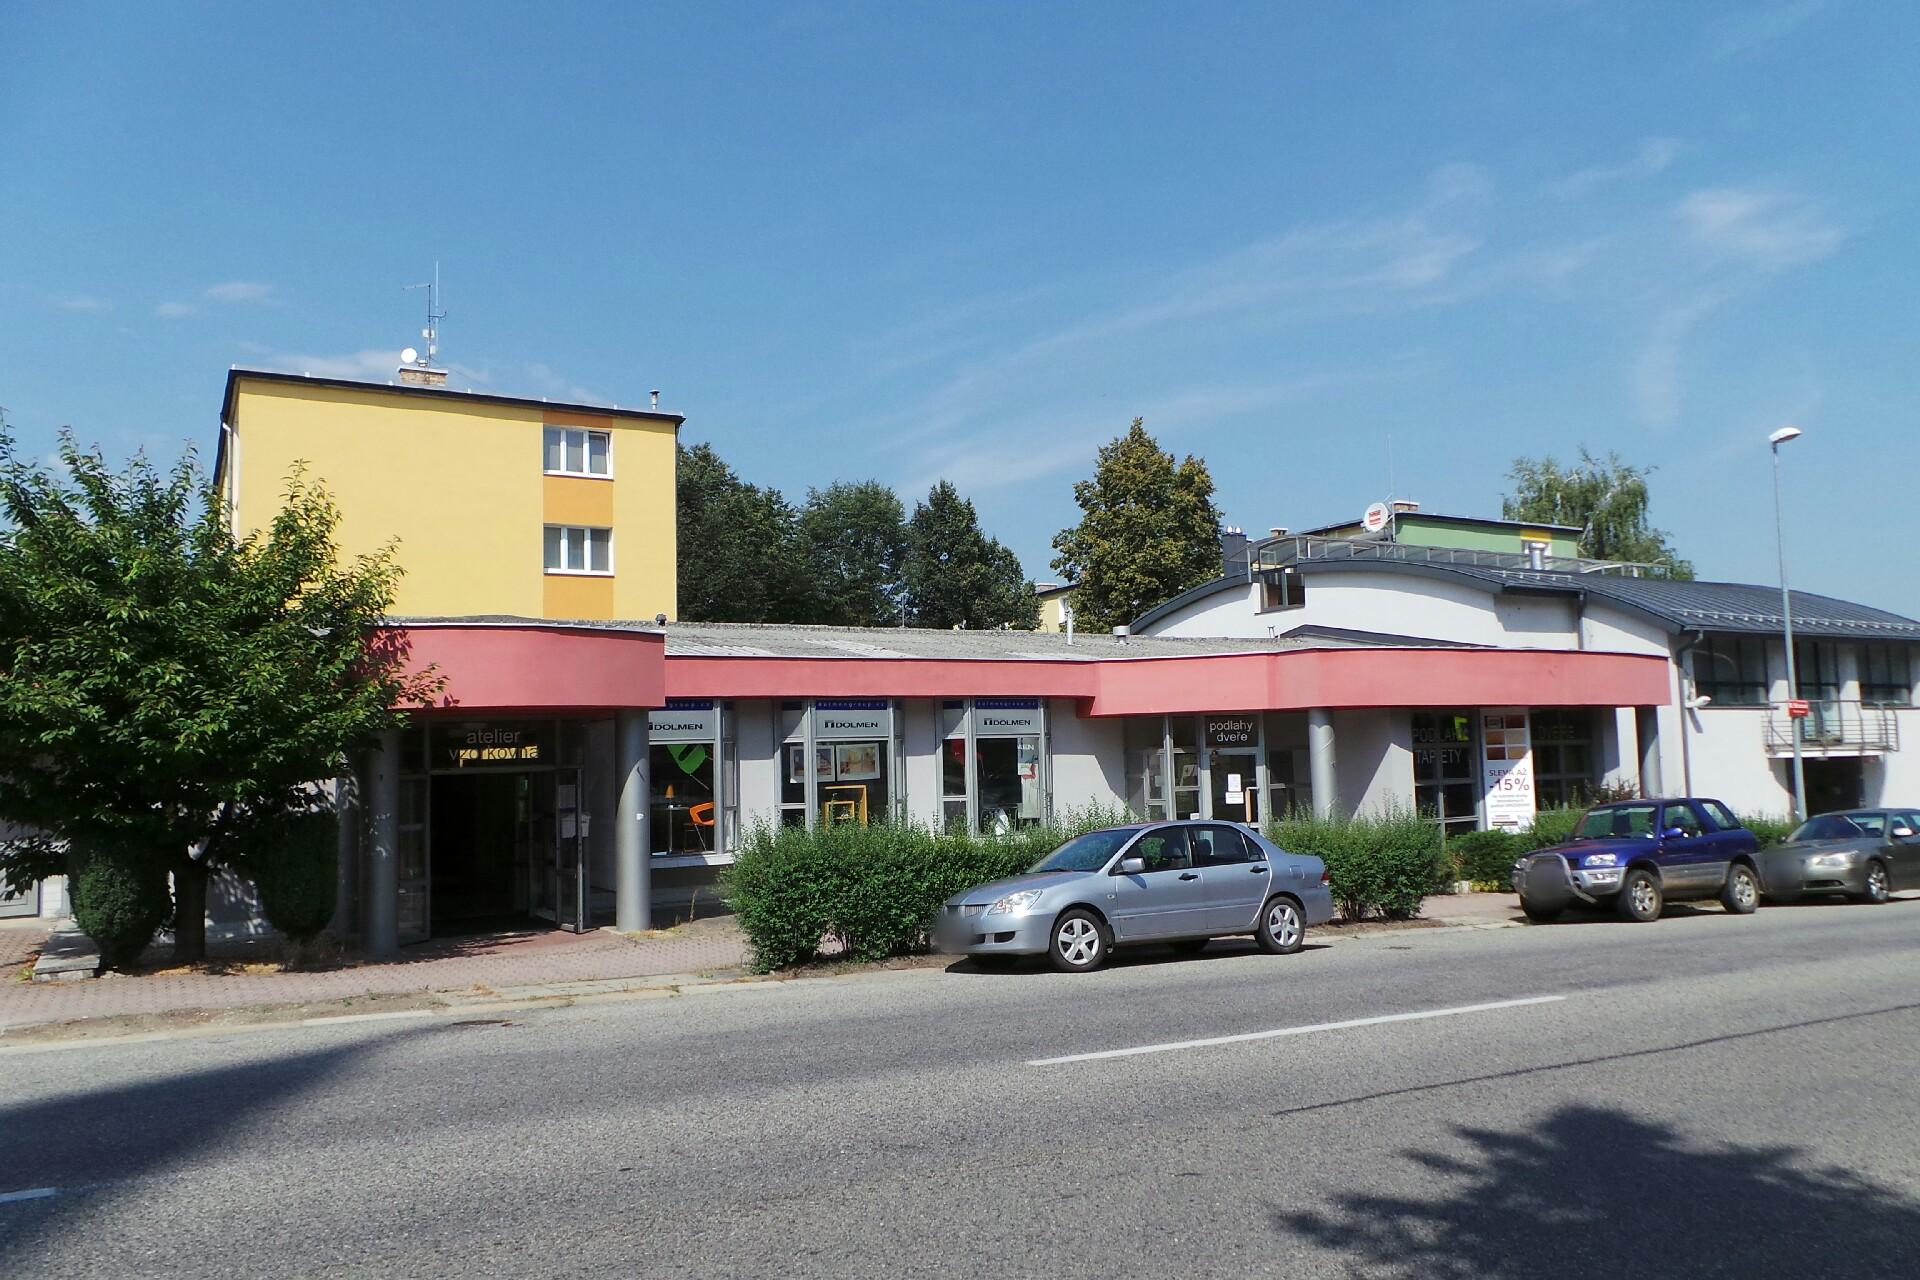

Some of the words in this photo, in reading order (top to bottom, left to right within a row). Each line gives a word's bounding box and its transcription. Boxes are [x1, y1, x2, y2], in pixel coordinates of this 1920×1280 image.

[1209, 720, 1253, 732] podlahy
[466, 728, 521, 744] atelier
[1216, 731, 1249, 742] dveře
[1415, 748, 1462, 765] TAPETY
[1489, 778, 1530, 791] -15%
